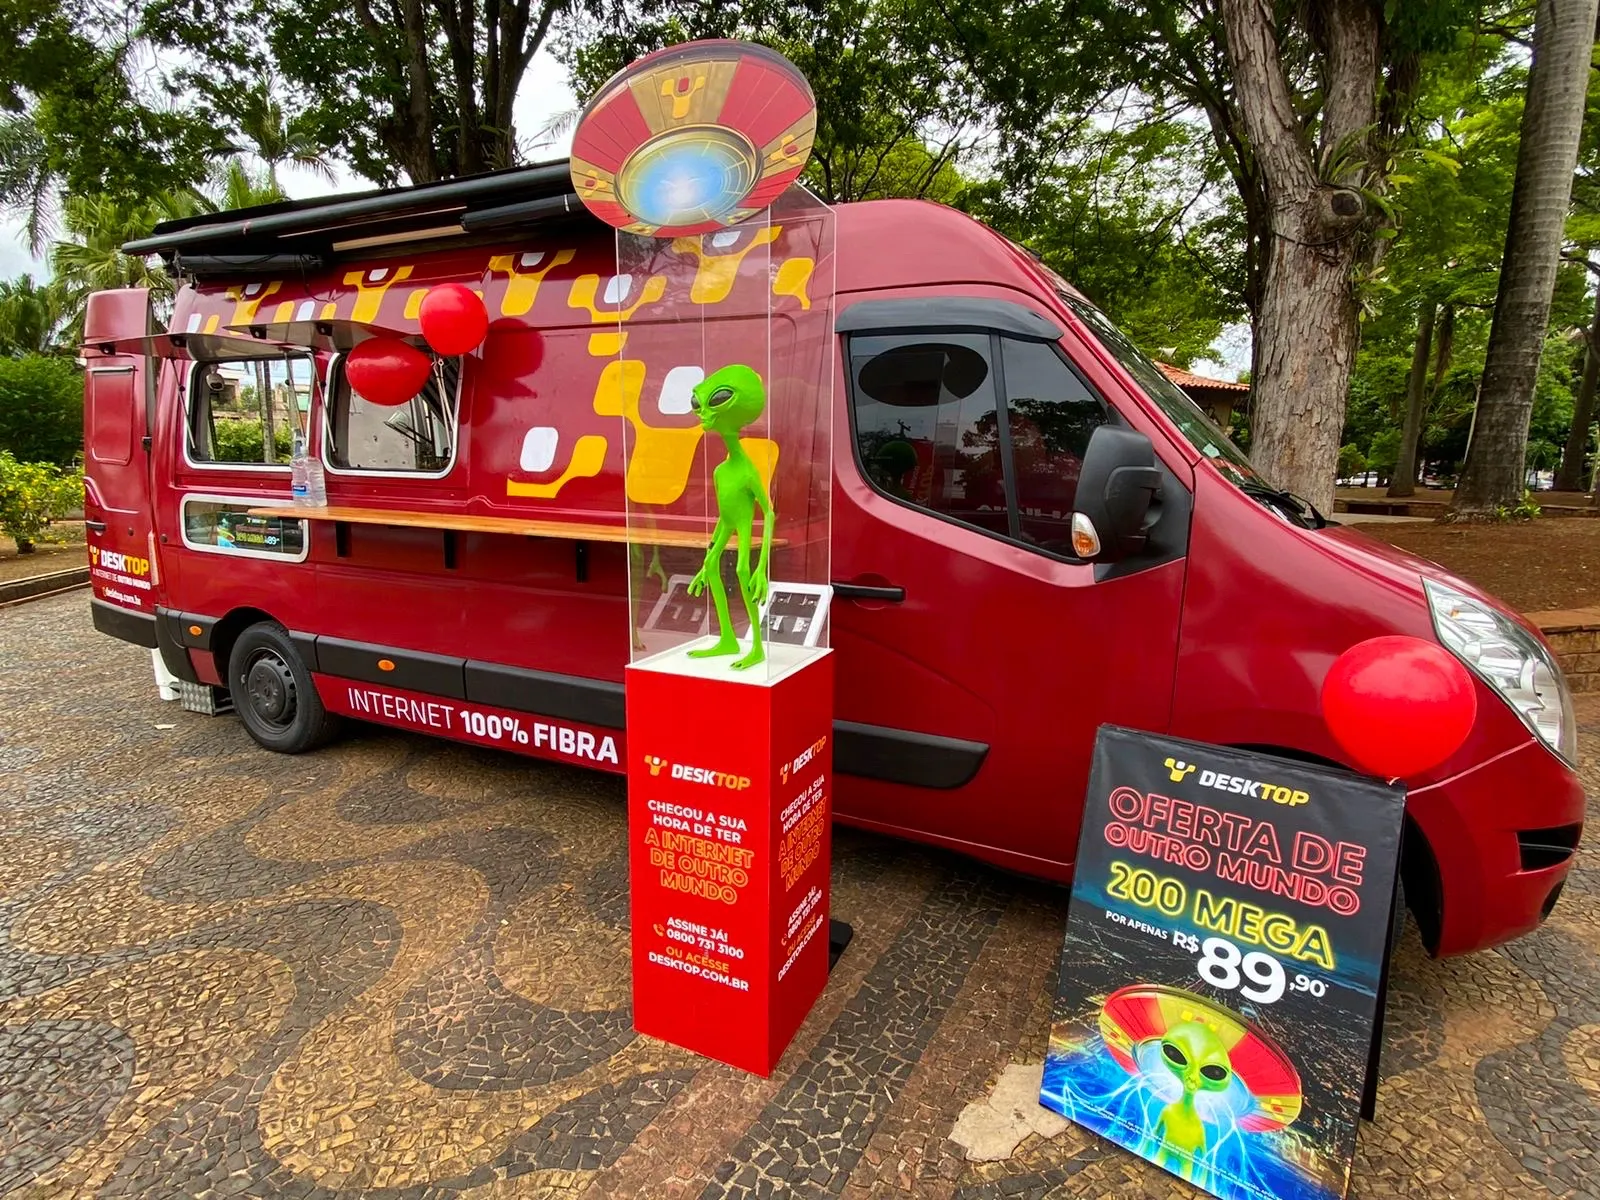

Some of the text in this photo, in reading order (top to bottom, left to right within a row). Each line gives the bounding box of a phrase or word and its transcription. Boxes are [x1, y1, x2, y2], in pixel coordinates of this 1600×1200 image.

[101, 549, 150, 576] DESKTOP
[348, 687, 619, 765] INTERNET 100% FIBRA
[792, 735, 827, 775] DESKTOP
[671, 763, 751, 790] DESKTOP
[1198, 769, 1311, 807] DESKTOP
[647, 799, 748, 831] CHEGOU A SUA
[780, 790, 807, 822] CHEGOU
[812, 774, 825, 790] SUA
[653, 813, 742, 844] HORA DE TER
[783, 810, 801, 834] HORA
[1108, 786, 1367, 886] OFERTA DE
[644, 827, 755, 868] A INTERNET
[650, 847, 748, 887] DE OUTRO
[660, 869, 738, 905] MUNDO
[1104, 821, 1361, 916] OUTRO MUNDO
[667, 917, 728, 942] ASSINE JÁ!
[1105, 910, 1127, 927] POR
[1126, 918, 1168, 940] APENAS
[1172, 930, 1200, 954] R$
[1106, 861, 1337, 971] 200 MEGA
[665, 946, 683, 958] OU
[666, 929, 744, 959] 0800 731 3100
[648, 952, 749, 992] DESKTOP.COM.BR
